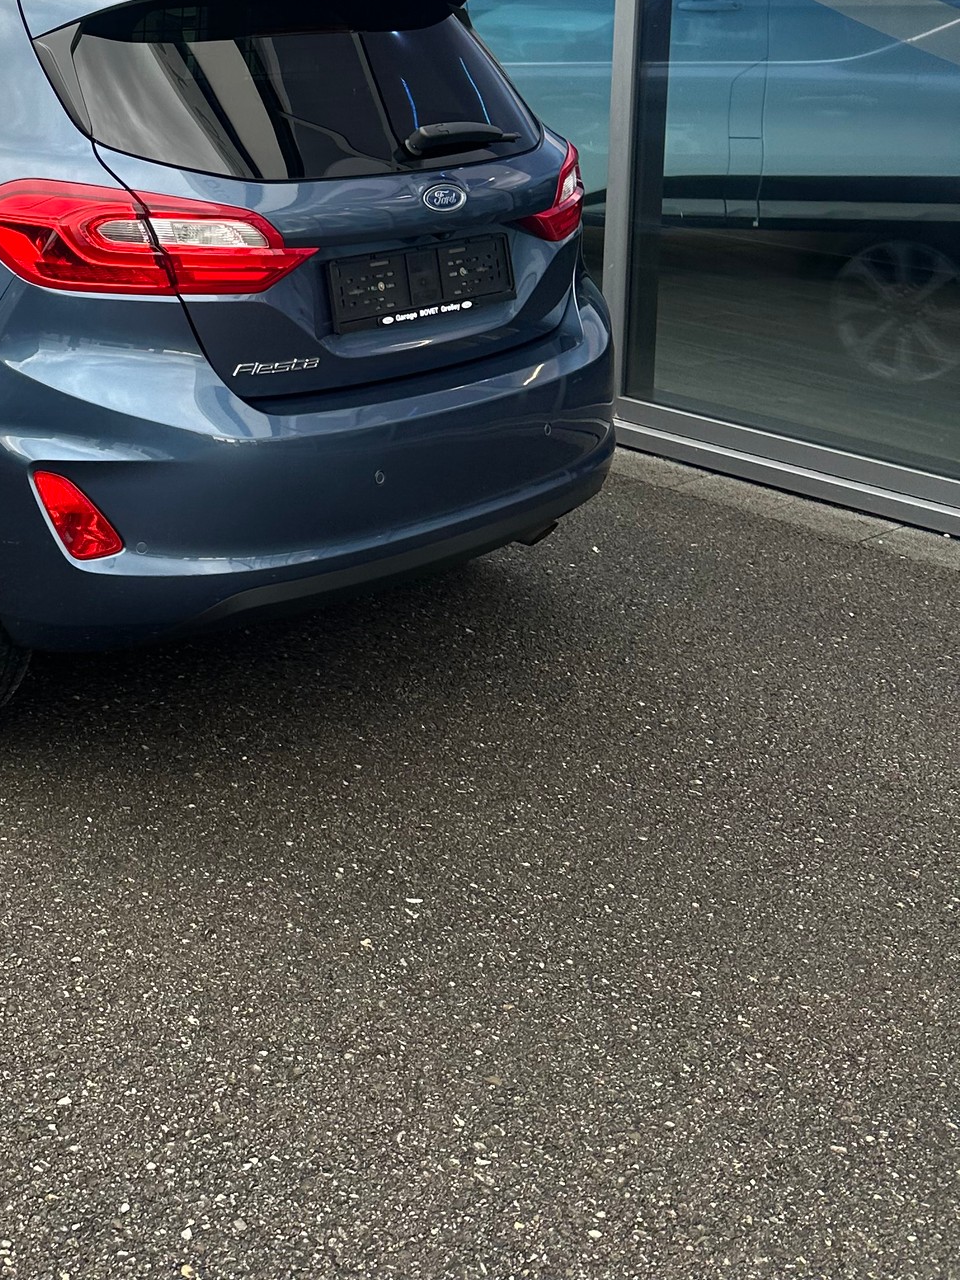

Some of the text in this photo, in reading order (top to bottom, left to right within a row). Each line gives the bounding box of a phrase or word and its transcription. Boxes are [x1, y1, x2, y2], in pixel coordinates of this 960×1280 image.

[434, 190, 457, 206] Ford
[395, 312, 418, 322] Garage
[420, 307, 439, 317] BOVET
